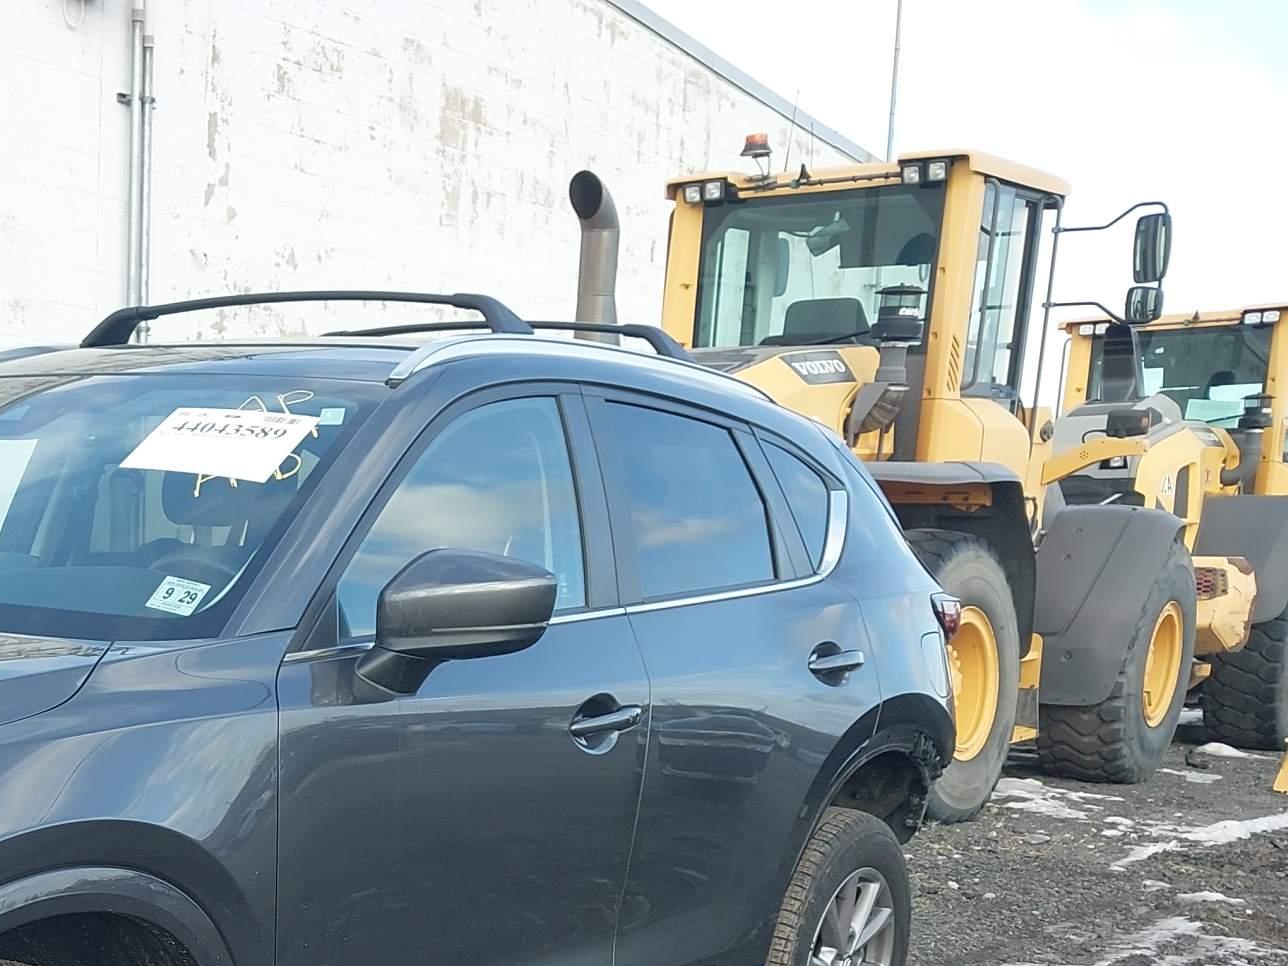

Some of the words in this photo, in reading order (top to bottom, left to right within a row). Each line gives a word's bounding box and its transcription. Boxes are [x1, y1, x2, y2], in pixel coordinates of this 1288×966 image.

[791, 359, 846, 376] VOLVO
[172, 420, 288, 439] 44043589
[162, 587, 175, 600] 9
[177, 590, 199, 605] 29
